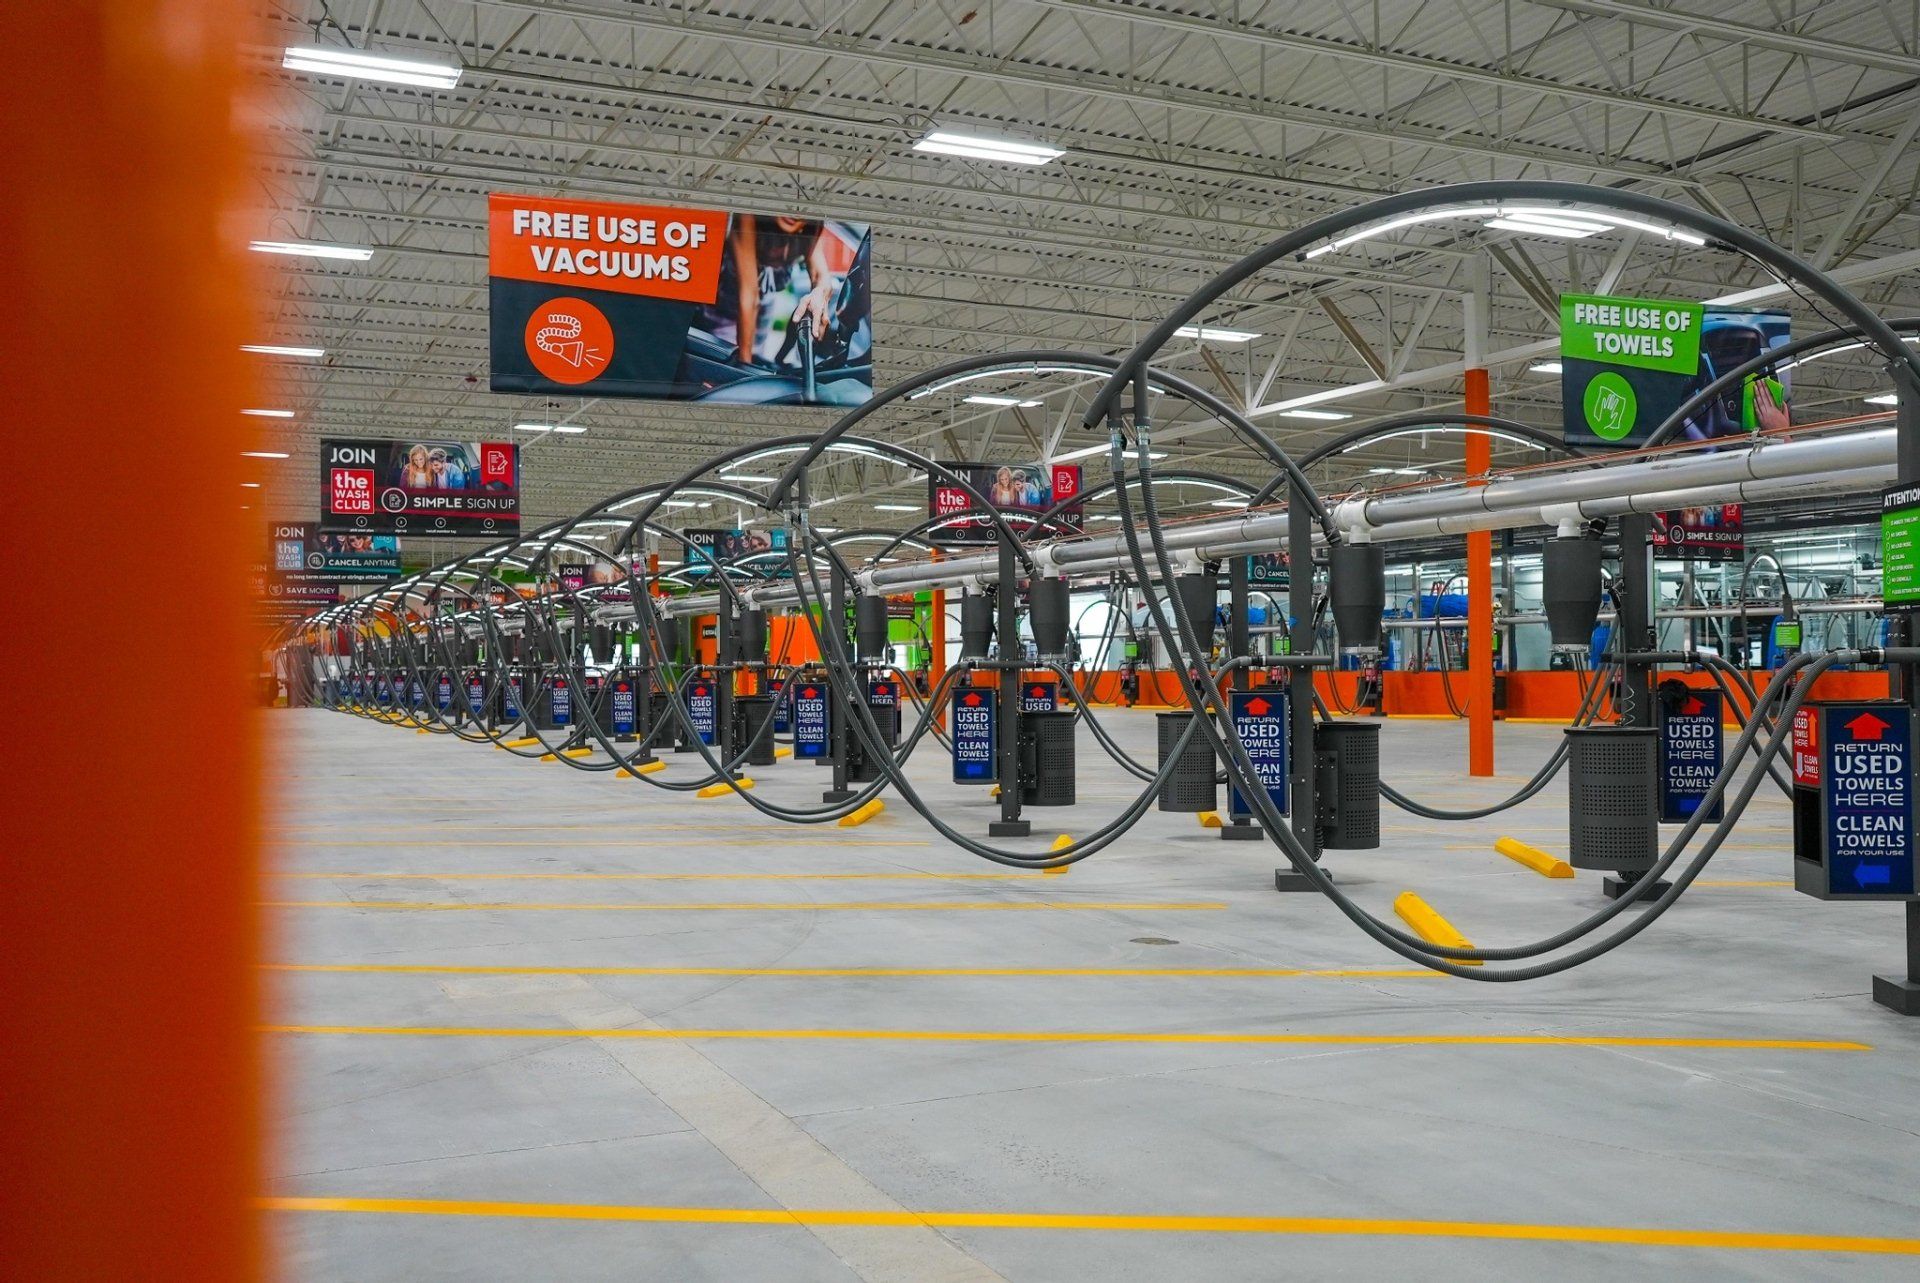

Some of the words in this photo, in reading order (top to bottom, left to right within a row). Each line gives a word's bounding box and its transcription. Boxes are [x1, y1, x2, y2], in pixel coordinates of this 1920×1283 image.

[513, 209, 590, 240] FREE
[597, 216, 657, 246] USE
[663, 222, 706, 249] OF
[531, 245, 690, 282] VACUUMS
[1575, 303, 1620, 327] FREE
[1624, 308, 1661, 330] USE
[1665, 310, 1692, 332] OF
[1594, 332, 1673, 358] TOWELS
[330, 448, 376, 464] JOIN
[335, 472, 368, 489] the
[335, 490, 370, 499] WASH
[939, 490, 965, 505] the
[335, 500, 370, 510] CLUB
[414, 497, 462, 508] SIMPLE
[468, 498, 496, 509] SIGN
[500, 498, 515, 509] UP
[1068, 514, 1079, 523] UP
[274, 527, 304, 537] JOIN
[278, 542, 299, 554] the
[958, 713, 988, 722] USED
[1794, 718, 1808, 729] USED
[1237, 725, 1279, 737] USED
[1669, 725, 1714, 737] USED
[1669, 740, 1715, 749] TOWELS
[1834, 743, 1903, 752] RETURN
[1246, 749, 1280, 757] ERE
[1669, 751, 1714, 759] HERE
[1804, 755, 1818, 765] CLEAN
[1835, 755, 1902, 774] USED
[1670, 766, 1714, 776] CLEAN
[1804, 764, 1818, 774] TOWELS
[1835, 777, 1904, 790] TOWELS
[1836, 793, 1904, 806] HERE
[1836, 816, 1904, 831] CLEAN
[1836, 834, 1905, 847] TOWELS
